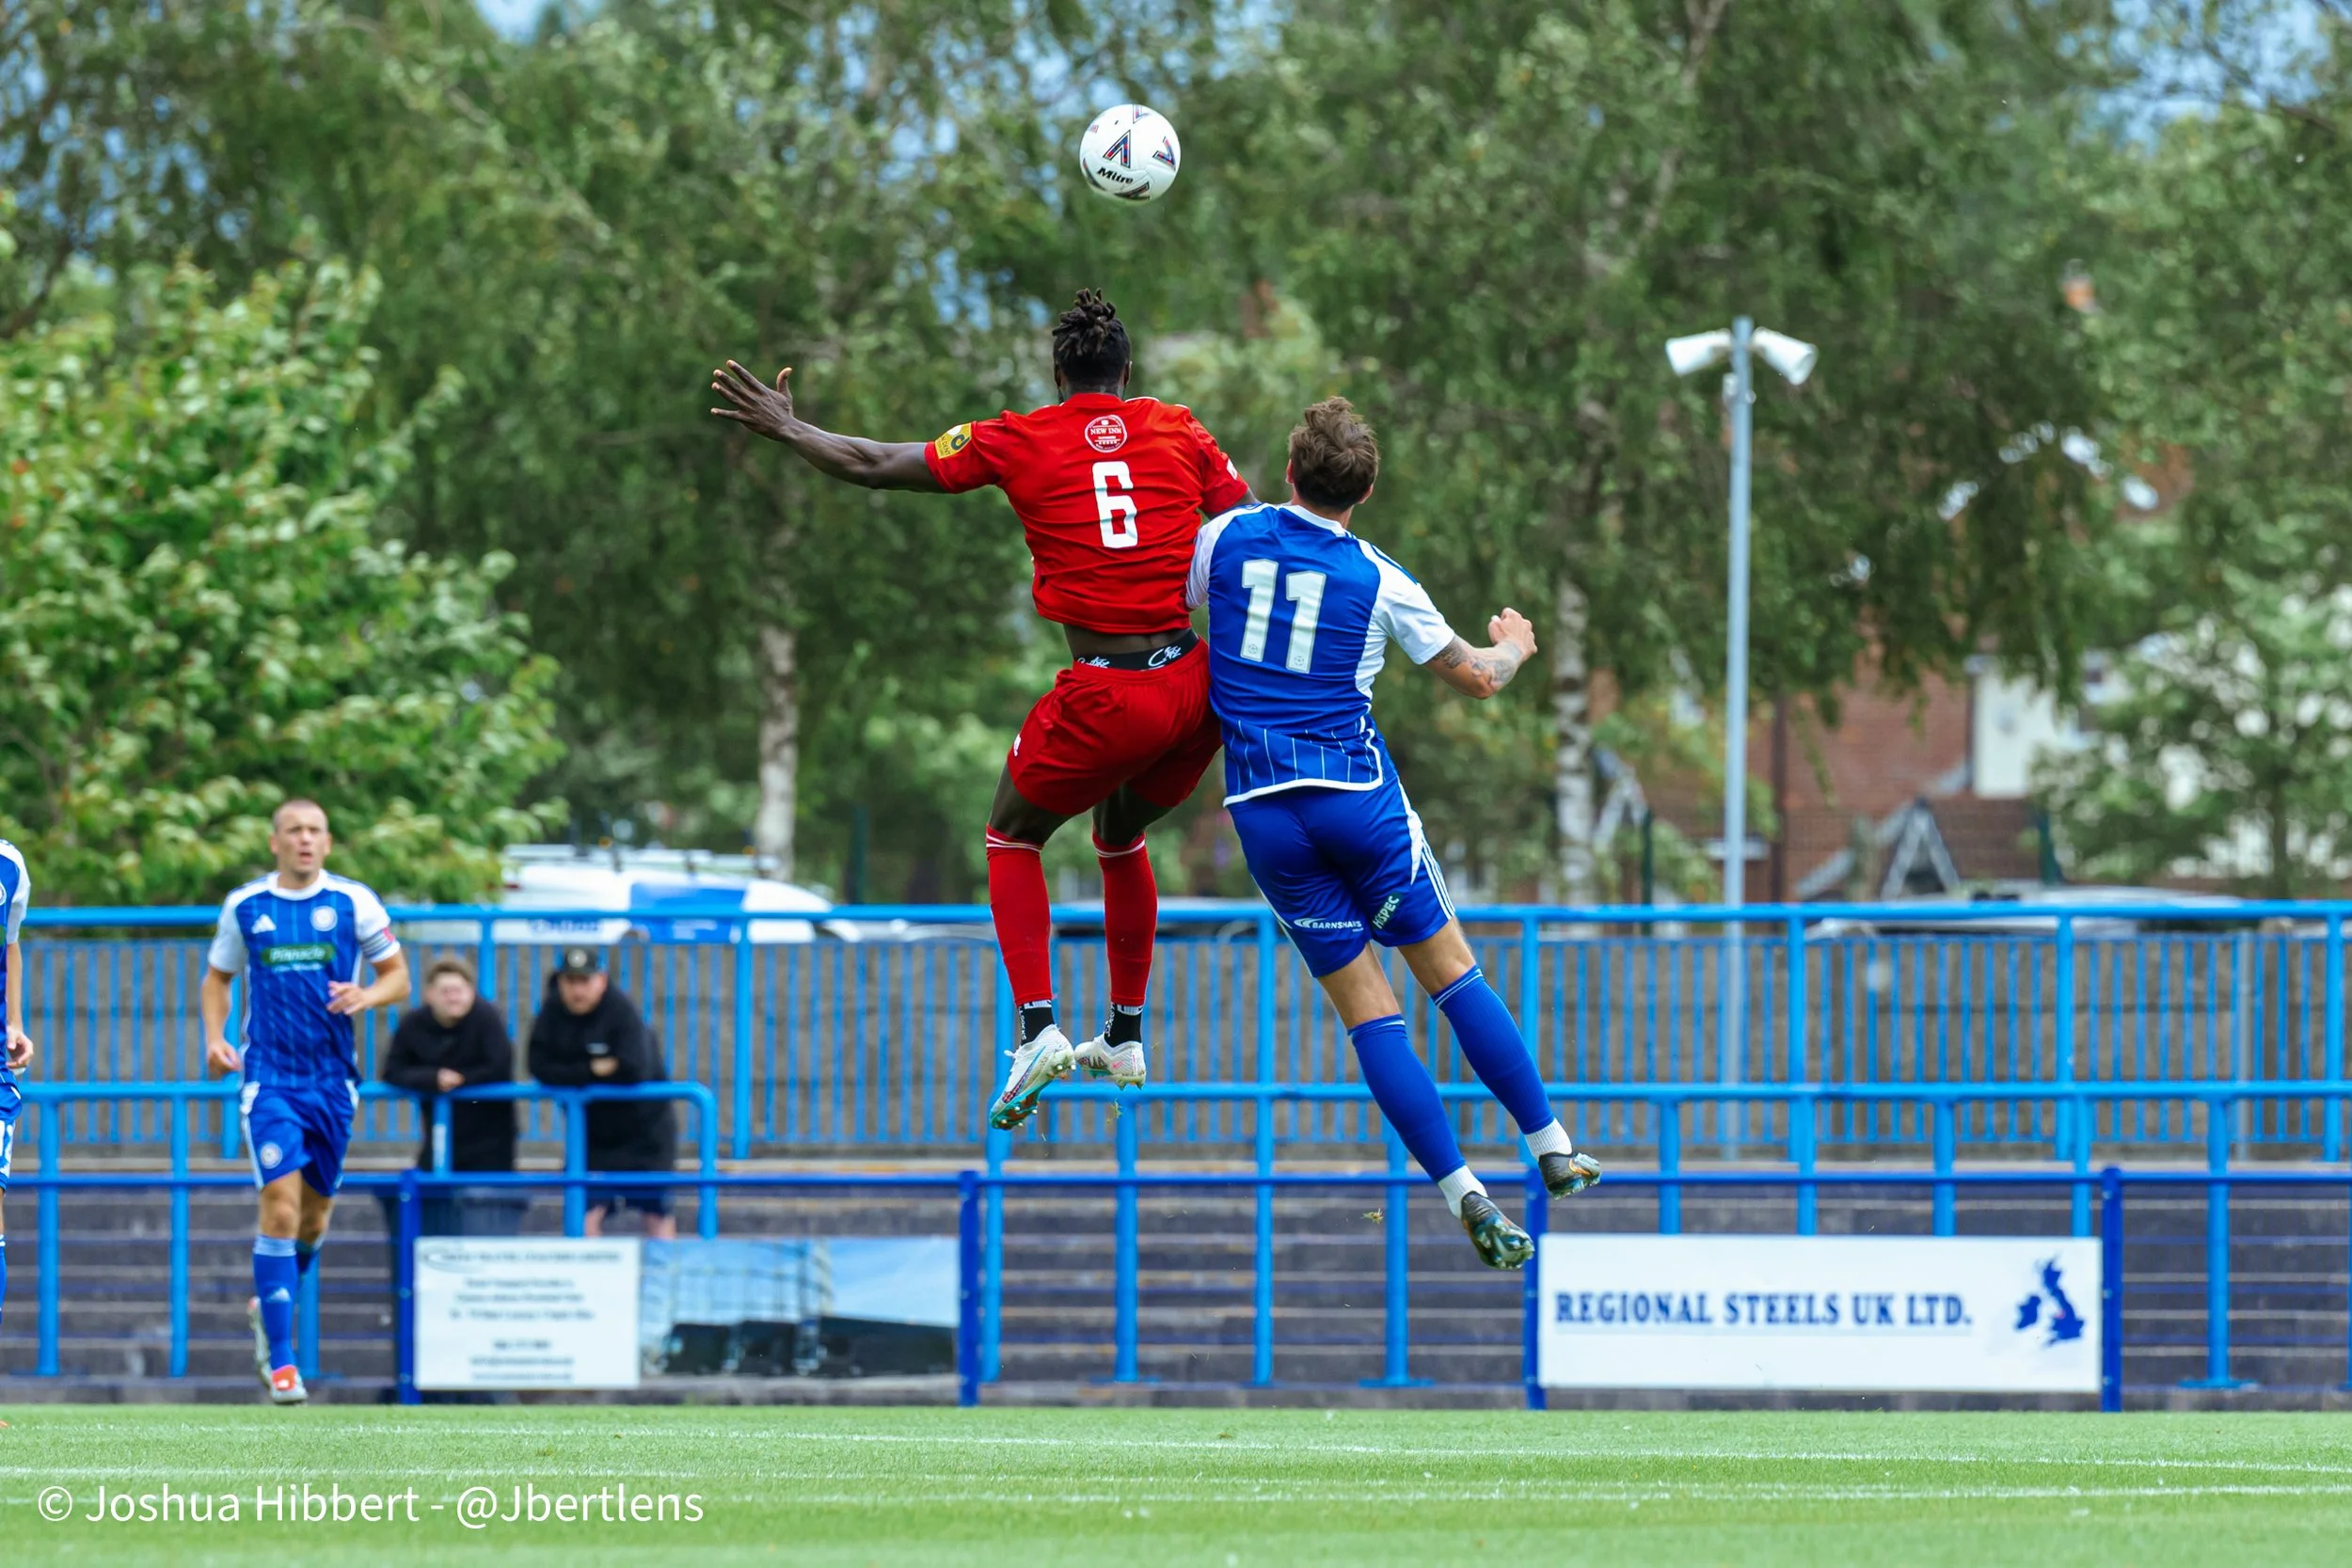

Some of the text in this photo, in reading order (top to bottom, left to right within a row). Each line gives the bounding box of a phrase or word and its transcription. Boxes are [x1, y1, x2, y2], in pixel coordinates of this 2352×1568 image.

[1097, 167, 1134, 184] Mitre
[1091, 461, 1138, 548] 6
[1240, 558, 1327, 674] 11
[1554, 1291, 1972, 1325] REGIONAL STEELS UK LTD.
